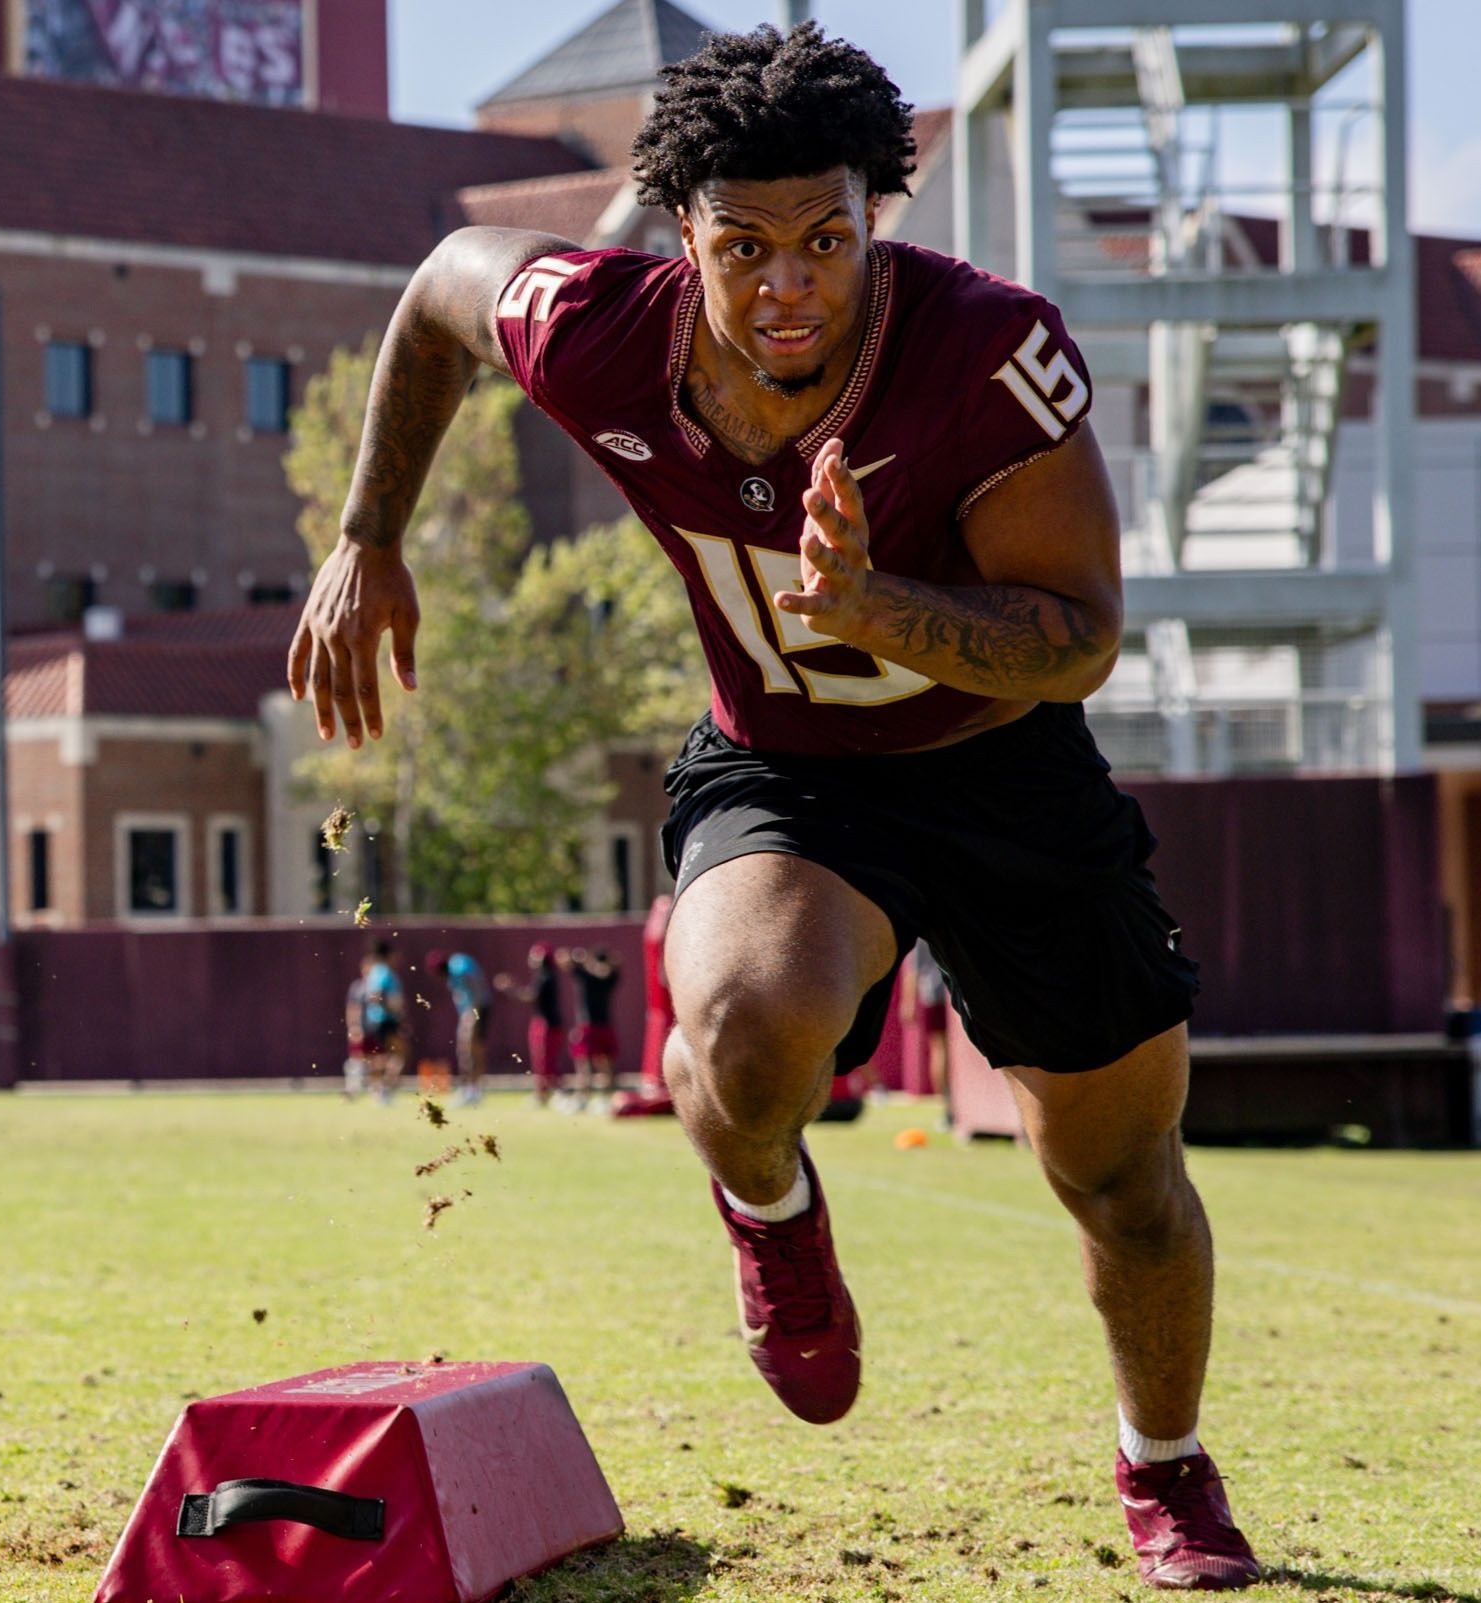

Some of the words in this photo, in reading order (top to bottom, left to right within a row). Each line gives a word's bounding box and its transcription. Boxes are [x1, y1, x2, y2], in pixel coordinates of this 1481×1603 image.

[497, 256, 592, 321] 15
[990, 319, 1089, 441] 15
[605, 436, 645, 455] ACC
[672, 525, 938, 707] 15
